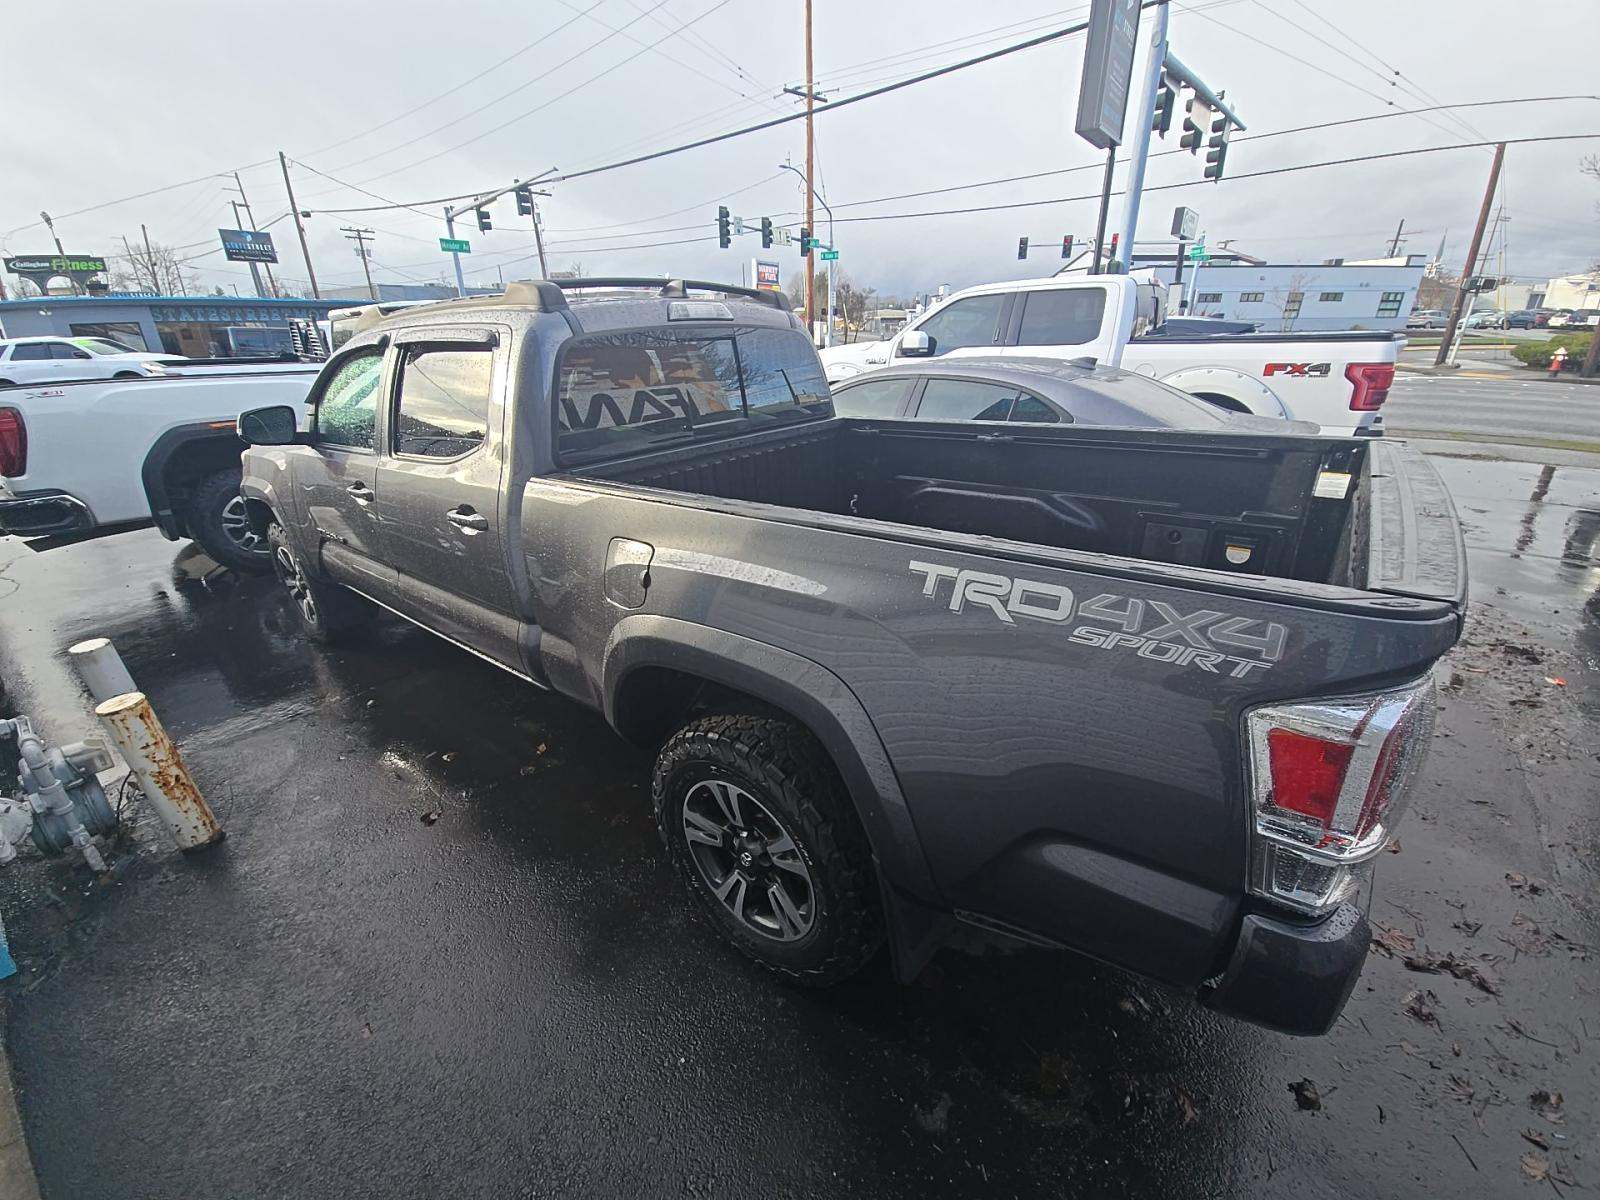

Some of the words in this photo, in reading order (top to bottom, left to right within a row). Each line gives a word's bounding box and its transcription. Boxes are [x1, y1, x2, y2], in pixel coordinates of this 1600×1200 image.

[51, 258, 104, 271] Fitness
[1263, 362, 1332, 377] FX4
[909, 559, 1077, 626] TRD
[1076, 593, 1289, 663] 4X4
[1067, 625, 1275, 679] SPORT
